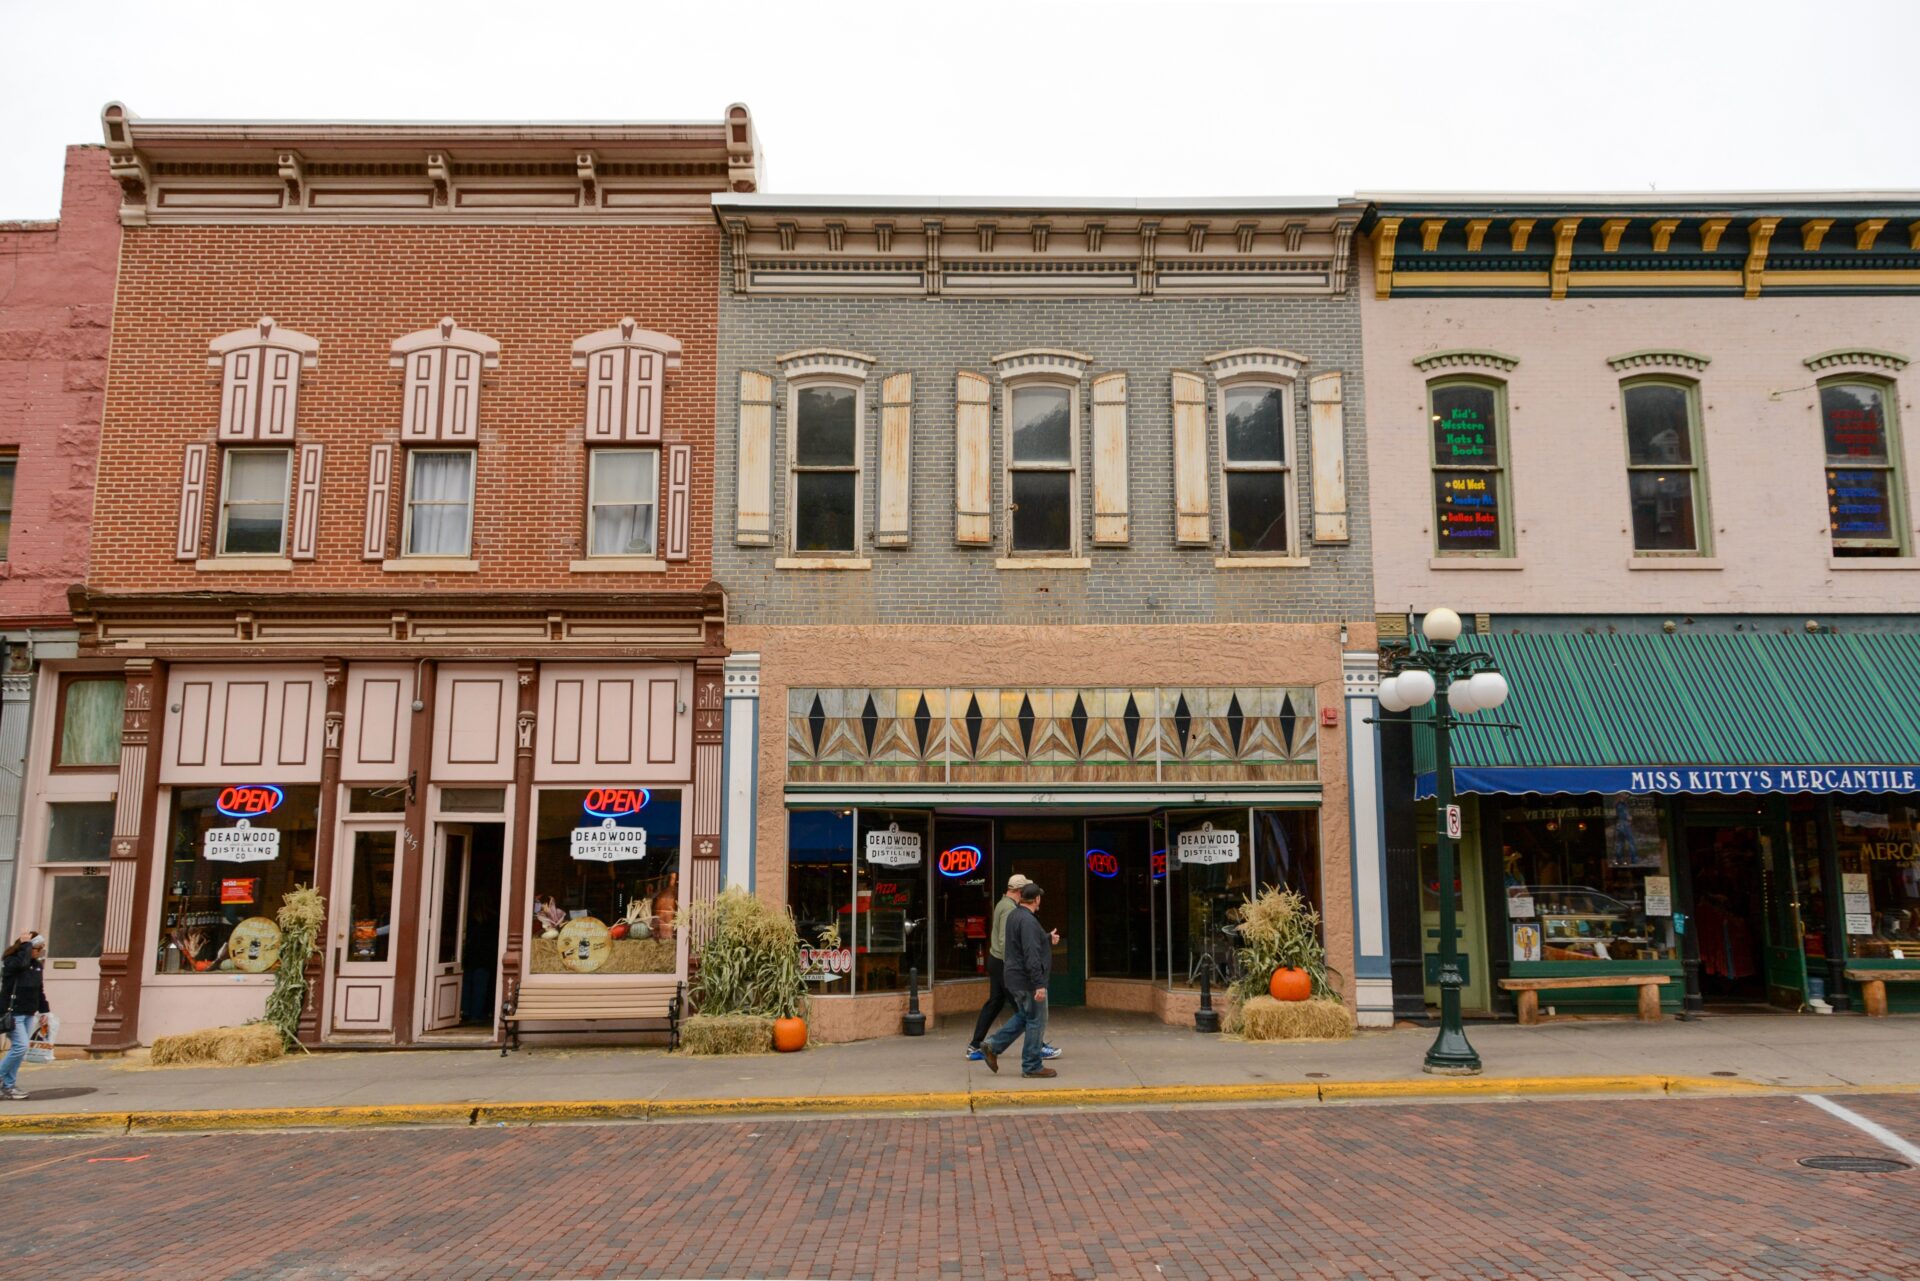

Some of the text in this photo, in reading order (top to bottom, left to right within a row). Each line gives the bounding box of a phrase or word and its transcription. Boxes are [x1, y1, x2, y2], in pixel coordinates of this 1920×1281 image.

[1441, 419, 1484, 430] Western
[1452, 445, 1484, 456] Boots
[1452, 479, 1486, 489] Old West
[1448, 512, 1473, 522] Dallas
[1631, 770, 1916, 790] MISS KITTY'S MERCANTILE
[220, 787, 278, 813] OPEN
[585, 788, 644, 813] OPEN
[209, 832, 276, 842] DEADWOOD
[404, 826, 418, 851] 645
[575, 831, 642, 841] DEADWOOD
[869, 835, 918, 846] DEADWOOD
[1181, 834, 1236, 845] DEADWOOD
[211, 847, 271, 855] DISTILLING
[578, 846, 638, 855] DISTILLING
[871, 850, 916, 859] DISTILLING
[1184, 849, 1233, 858] DISTILLING
[940, 850, 977, 871] OPEN
